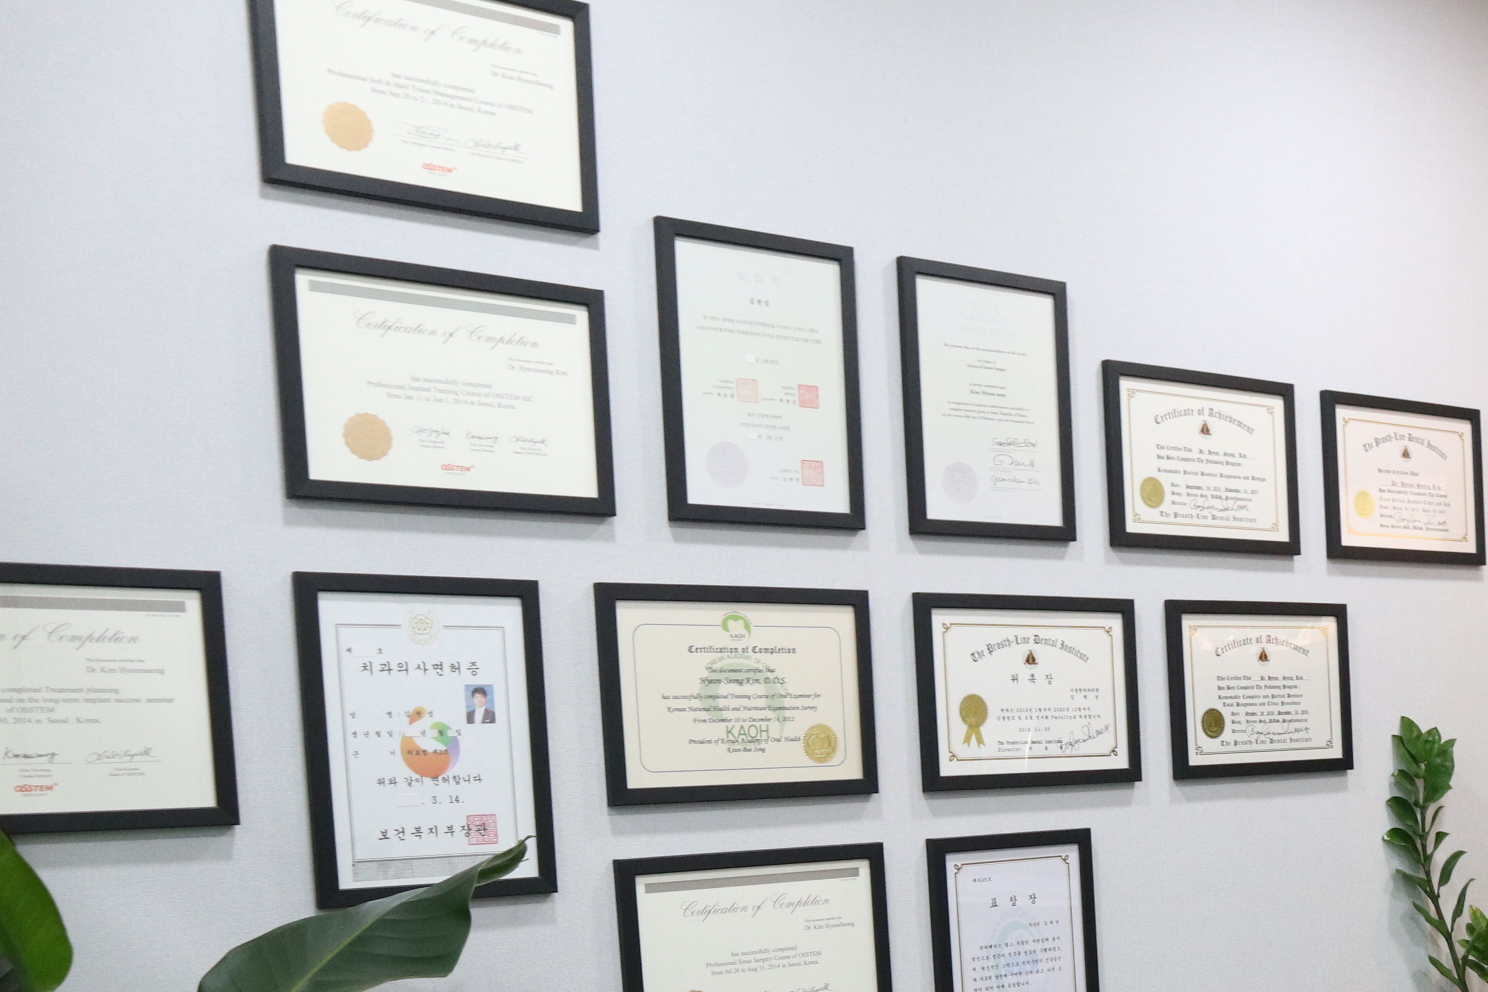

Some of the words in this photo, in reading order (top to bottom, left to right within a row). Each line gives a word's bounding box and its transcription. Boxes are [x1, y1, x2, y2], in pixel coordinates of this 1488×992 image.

[353, 310, 438, 338] Certification
[442, 324, 463, 344] of
[466, 324, 541, 350] Completion
[1154, 408, 1194, 424] Certificate
[1197, 407, 1205, 416] of
[1208, 407, 1255, 435] Achievement
[13, 625, 41, 650] of
[42, 622, 139, 651] Completion
[1215, 637, 1253, 657] Certificate
[1255, 635, 1263, 644] of
[1266, 634, 1310, 657] Achievement
[688, 645, 739, 654] Certification
[741, 645, 749, 654] of
[752, 645, 797, 655] Completion
[970, 650, 985, 662] The
[985, 635, 1030, 655] Prosth-Line
[1033, 634, 1058, 648] Dental
[1059, 640, 1090, 663] Institute
[726, 724, 769, 739] KAOH
[14, 783, 54, 792] OSSTEM
[376, 776, 398, 787] 위와
[431, 774, 483, 787] 면허합니다
[680, 899, 748, 923] Certification
[751, 896, 769, 918] of
[770, 892, 830, 914] Completion
[798, 950, 822, 958] OSSTEM
